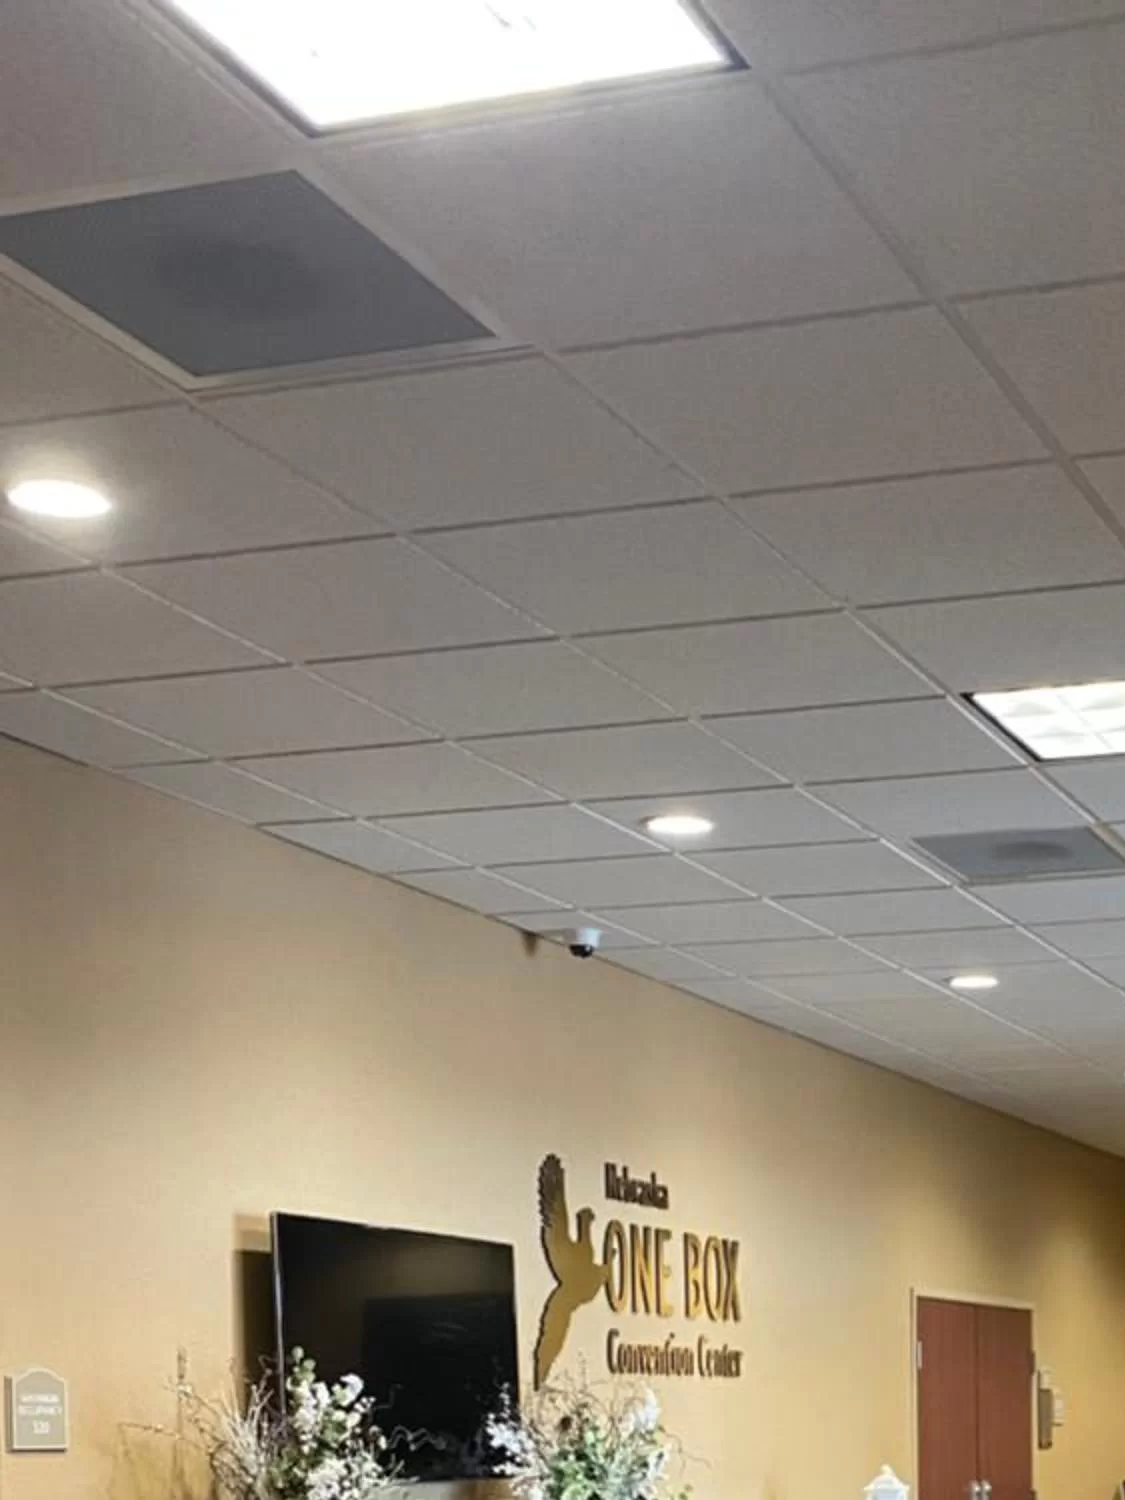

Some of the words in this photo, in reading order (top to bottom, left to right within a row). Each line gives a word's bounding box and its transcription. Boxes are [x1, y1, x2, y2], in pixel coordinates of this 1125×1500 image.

[602, 1218, 673, 1318] ONE
[683, 1231, 741, 1323] BOX
[606, 1328, 695, 1377] Convention
